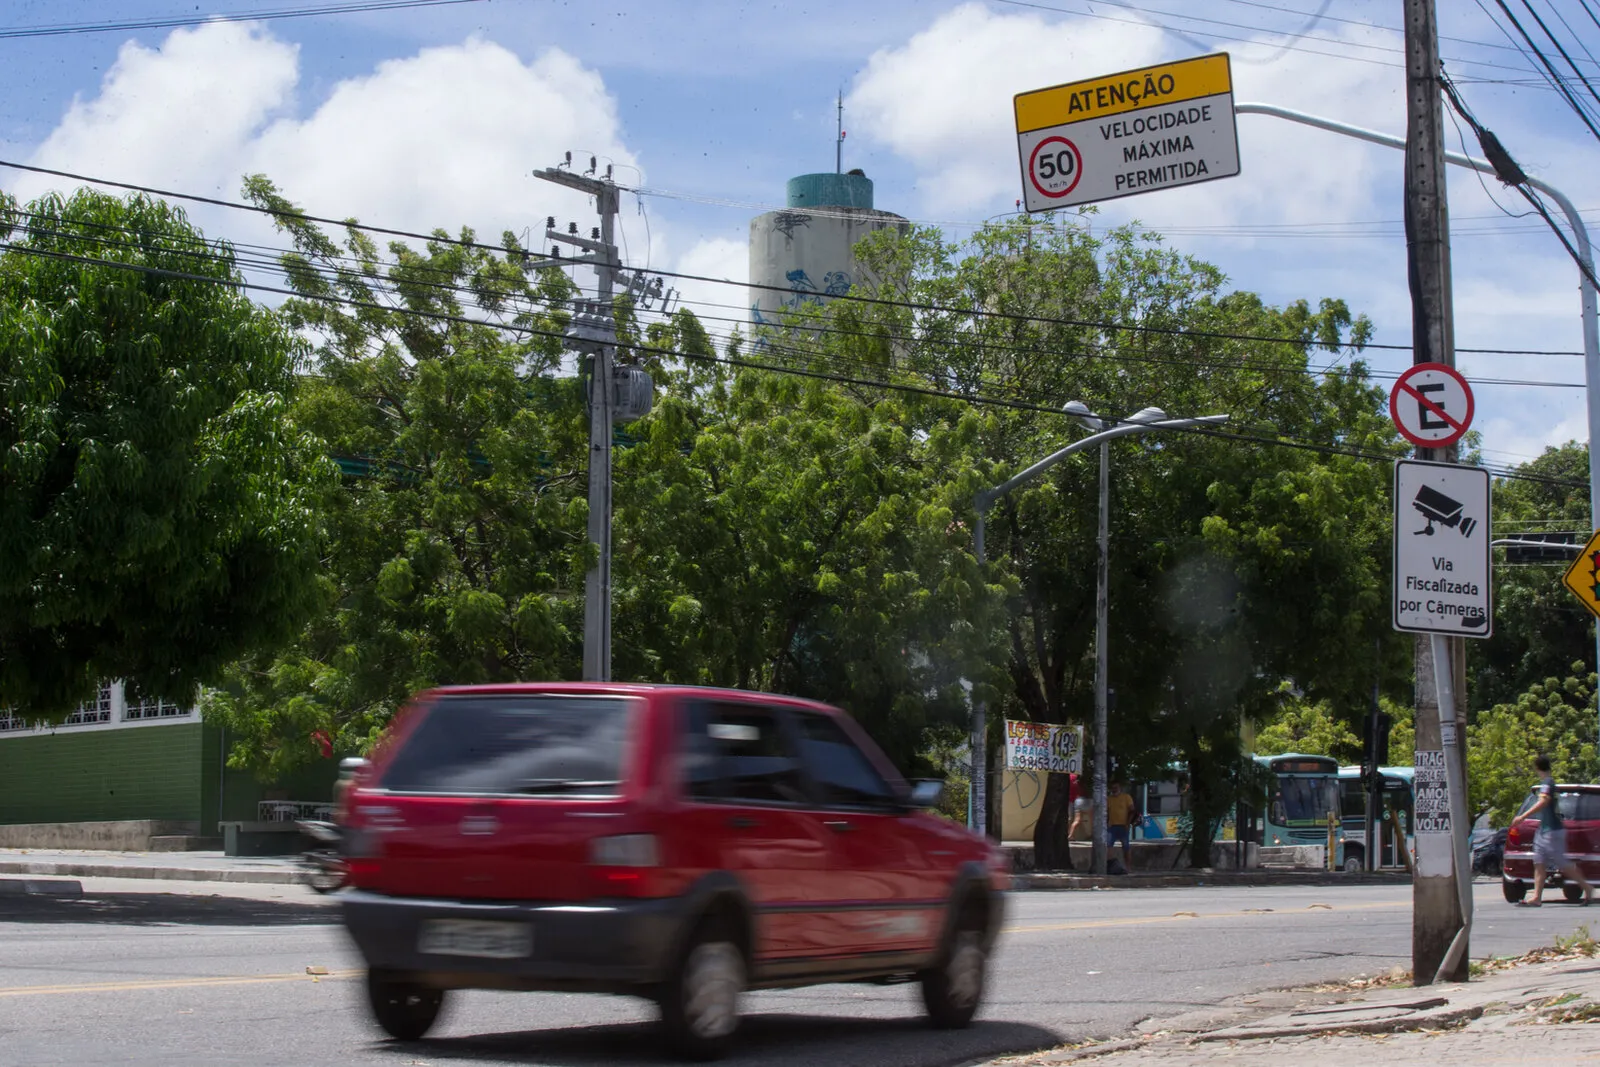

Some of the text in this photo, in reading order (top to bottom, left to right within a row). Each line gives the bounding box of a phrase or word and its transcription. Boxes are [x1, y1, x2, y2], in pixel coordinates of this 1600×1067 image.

[1068, 73, 1175, 114] ATENÇÃO
[1099, 105, 1212, 140] VELOCIDADE
[1123, 135, 1194, 163] MÁXIMA
[1039, 150, 1074, 180] 50
[1115, 159, 1209, 190] PERMITIDA
[1416, 383, 1449, 430] E
[1432, 557, 1453, 571] Via
[1406, 576, 1479, 595] Fiscalizada
[1400, 599, 1485, 617] por Câmeras
[1008, 721, 1050, 740] LOTES
[1015, 746, 1049, 758] PRAIAS
[1416, 752, 1445, 767] TRAG
[1416, 819, 1450, 830] VOLTA
